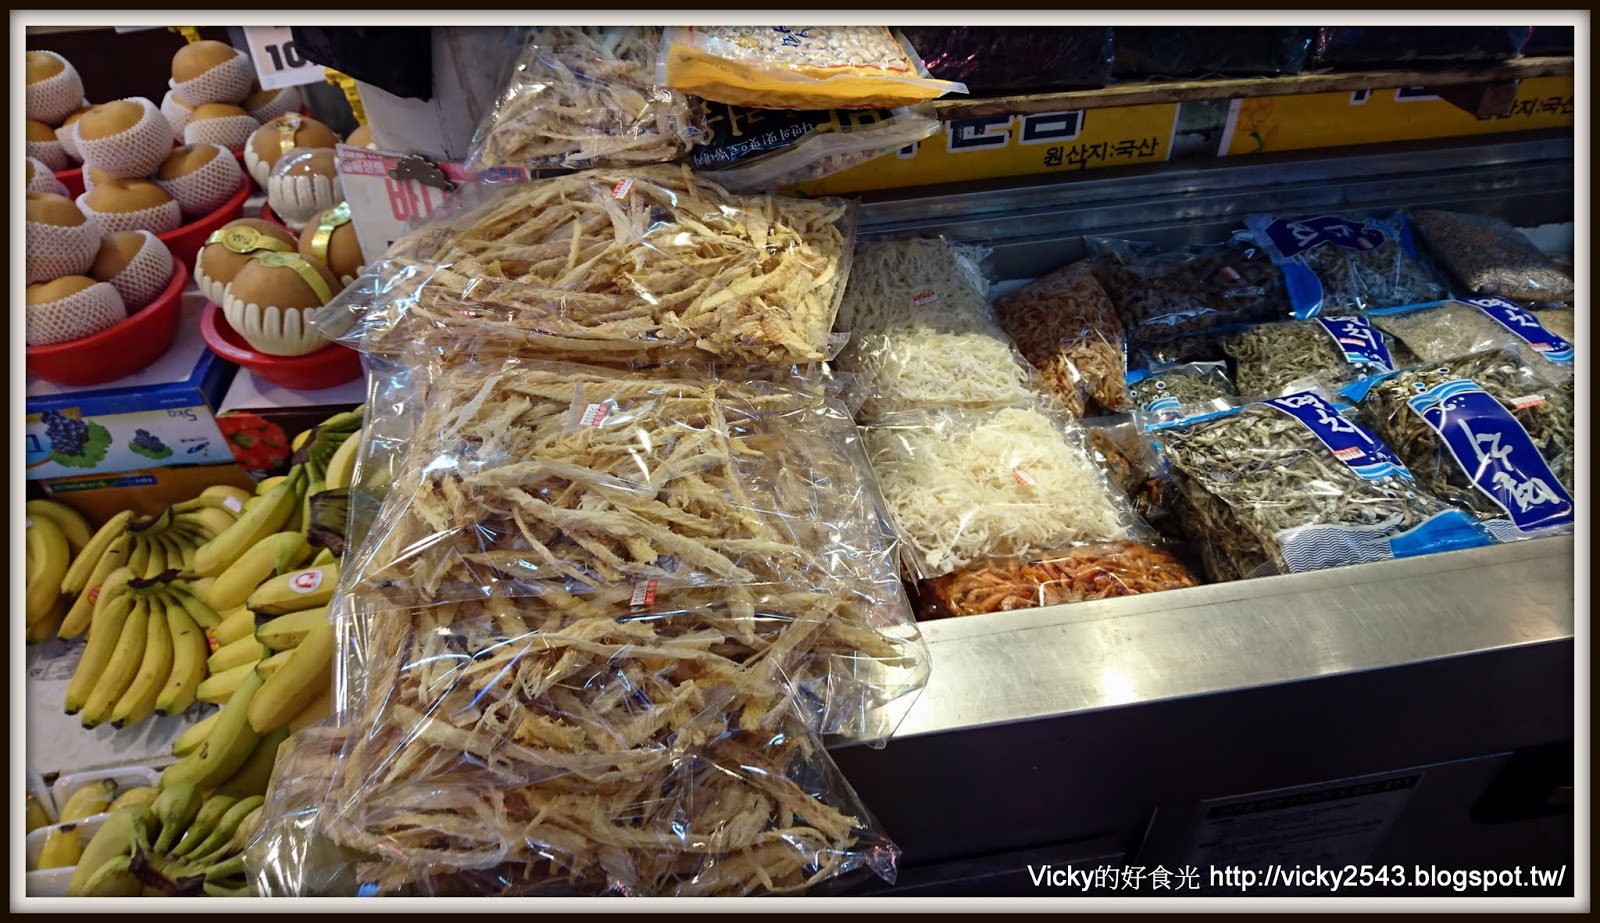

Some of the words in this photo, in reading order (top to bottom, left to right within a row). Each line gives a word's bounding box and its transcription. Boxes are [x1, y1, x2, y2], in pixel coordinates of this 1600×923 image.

[779, 122, 814, 141] 나만의
[1044, 137, 1159, 169] 원산지:국산
[167, 408, 198, 422] 5kg
